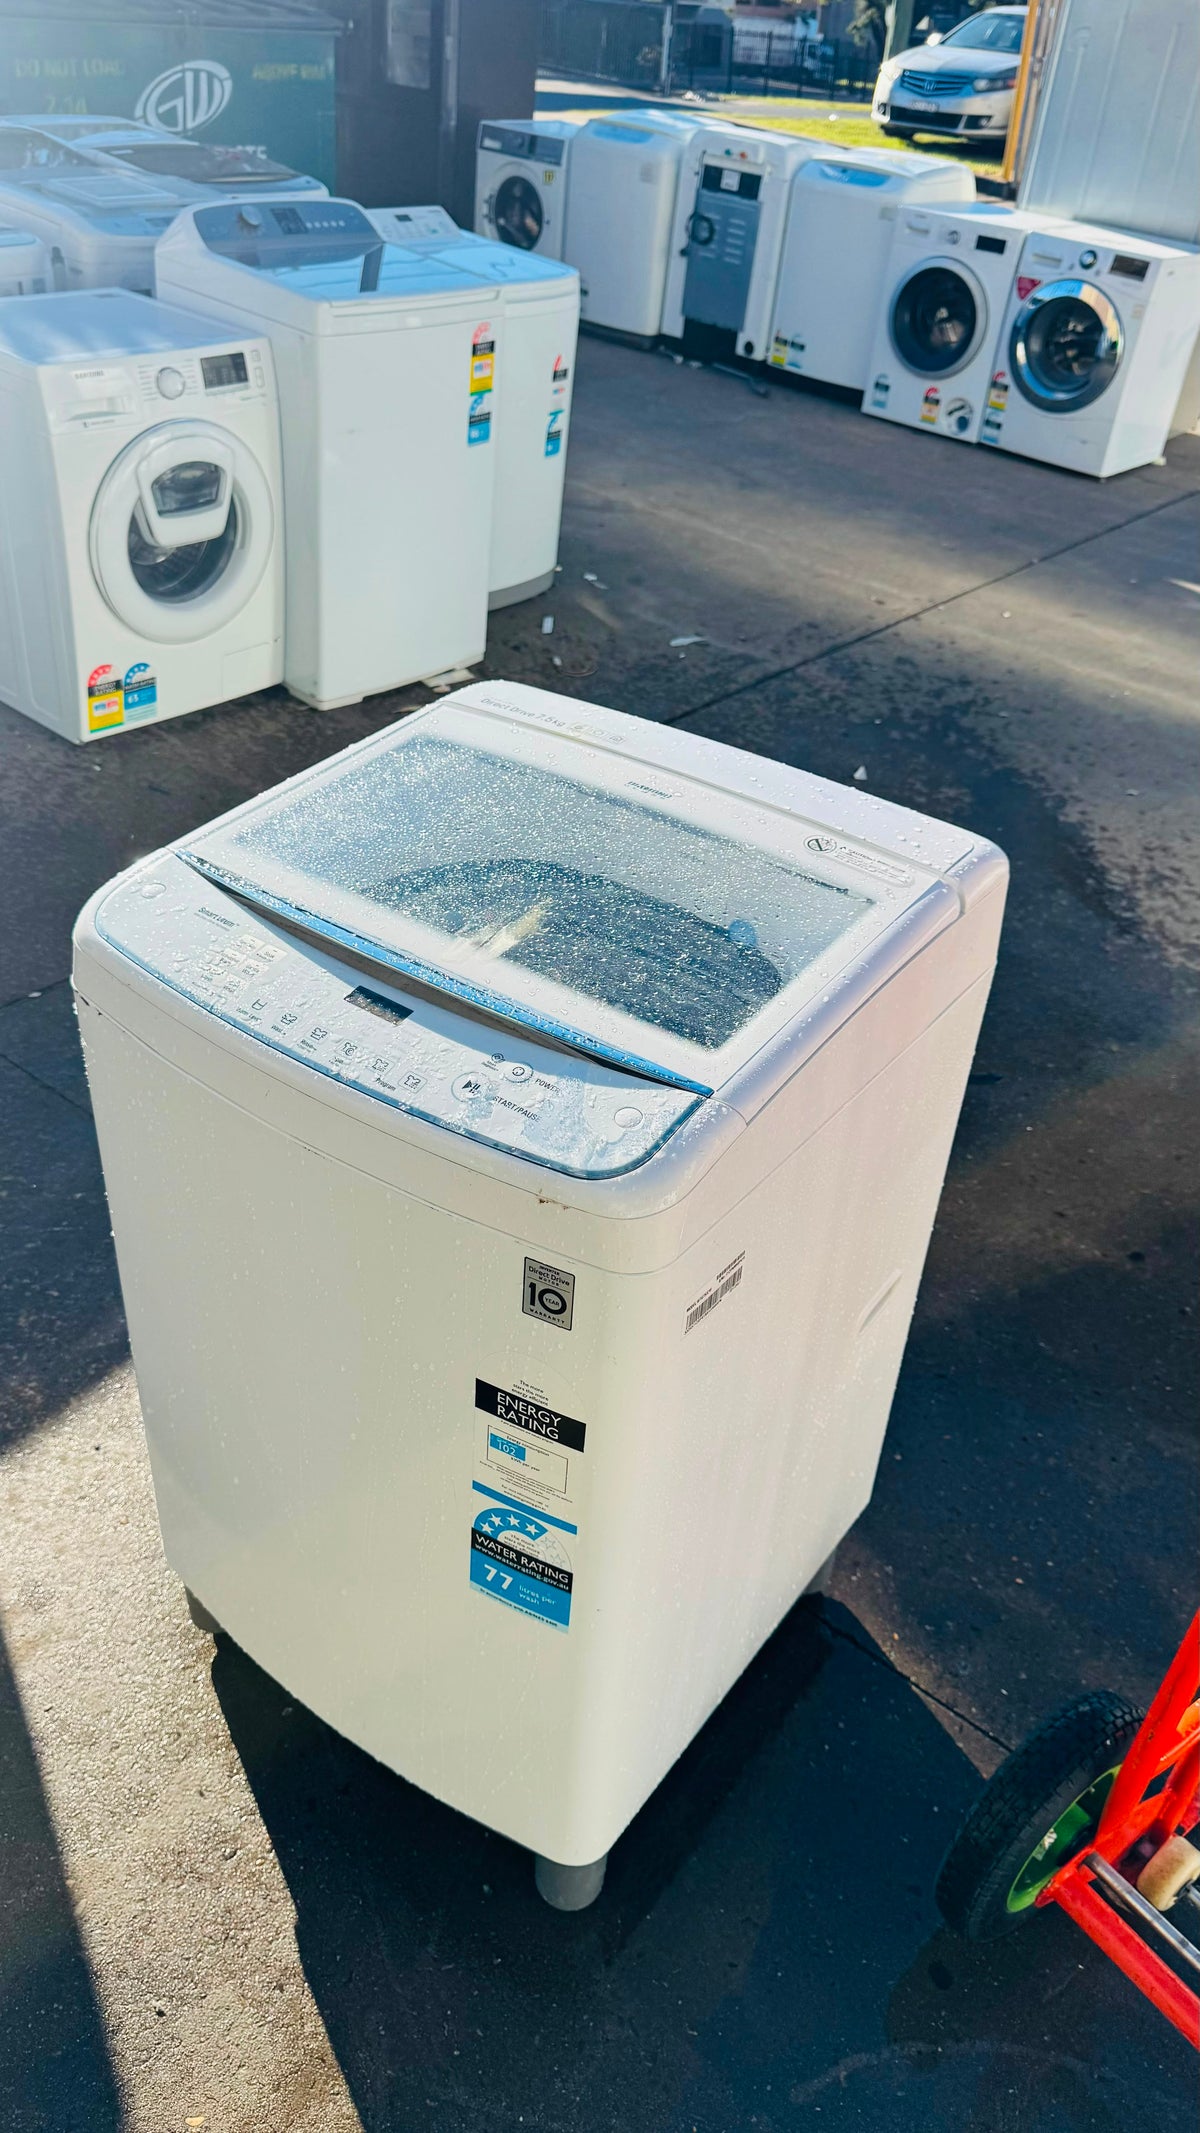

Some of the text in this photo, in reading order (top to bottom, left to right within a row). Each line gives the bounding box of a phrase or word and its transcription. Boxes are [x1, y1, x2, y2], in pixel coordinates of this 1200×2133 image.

[480, 698, 510, 709] Direct
[510, 706, 535, 717] Drive
[492, 1095, 541, 1122] START/PAUSE
[528, 1266, 570, 1286] Direct Drive
[528, 1282, 567, 1315] 10
[544, 1296, 560, 1306] YEAR
[529, 1308, 565, 1324] WARRANTY
[520, 1379, 530, 1387] The
[497, 1391, 562, 1427] ENERGY
[497, 1404, 559, 1440] RATING
[497, 1440, 516, 1457] 102
[474, 1543, 570, 1591] www.waterrating.gov.au
[475, 1533, 570, 1584] WATER RATING
[483, 1563, 514, 1591] 77
[518, 1592, 540, 1606] wash
[519, 1585, 540, 1599] litres
